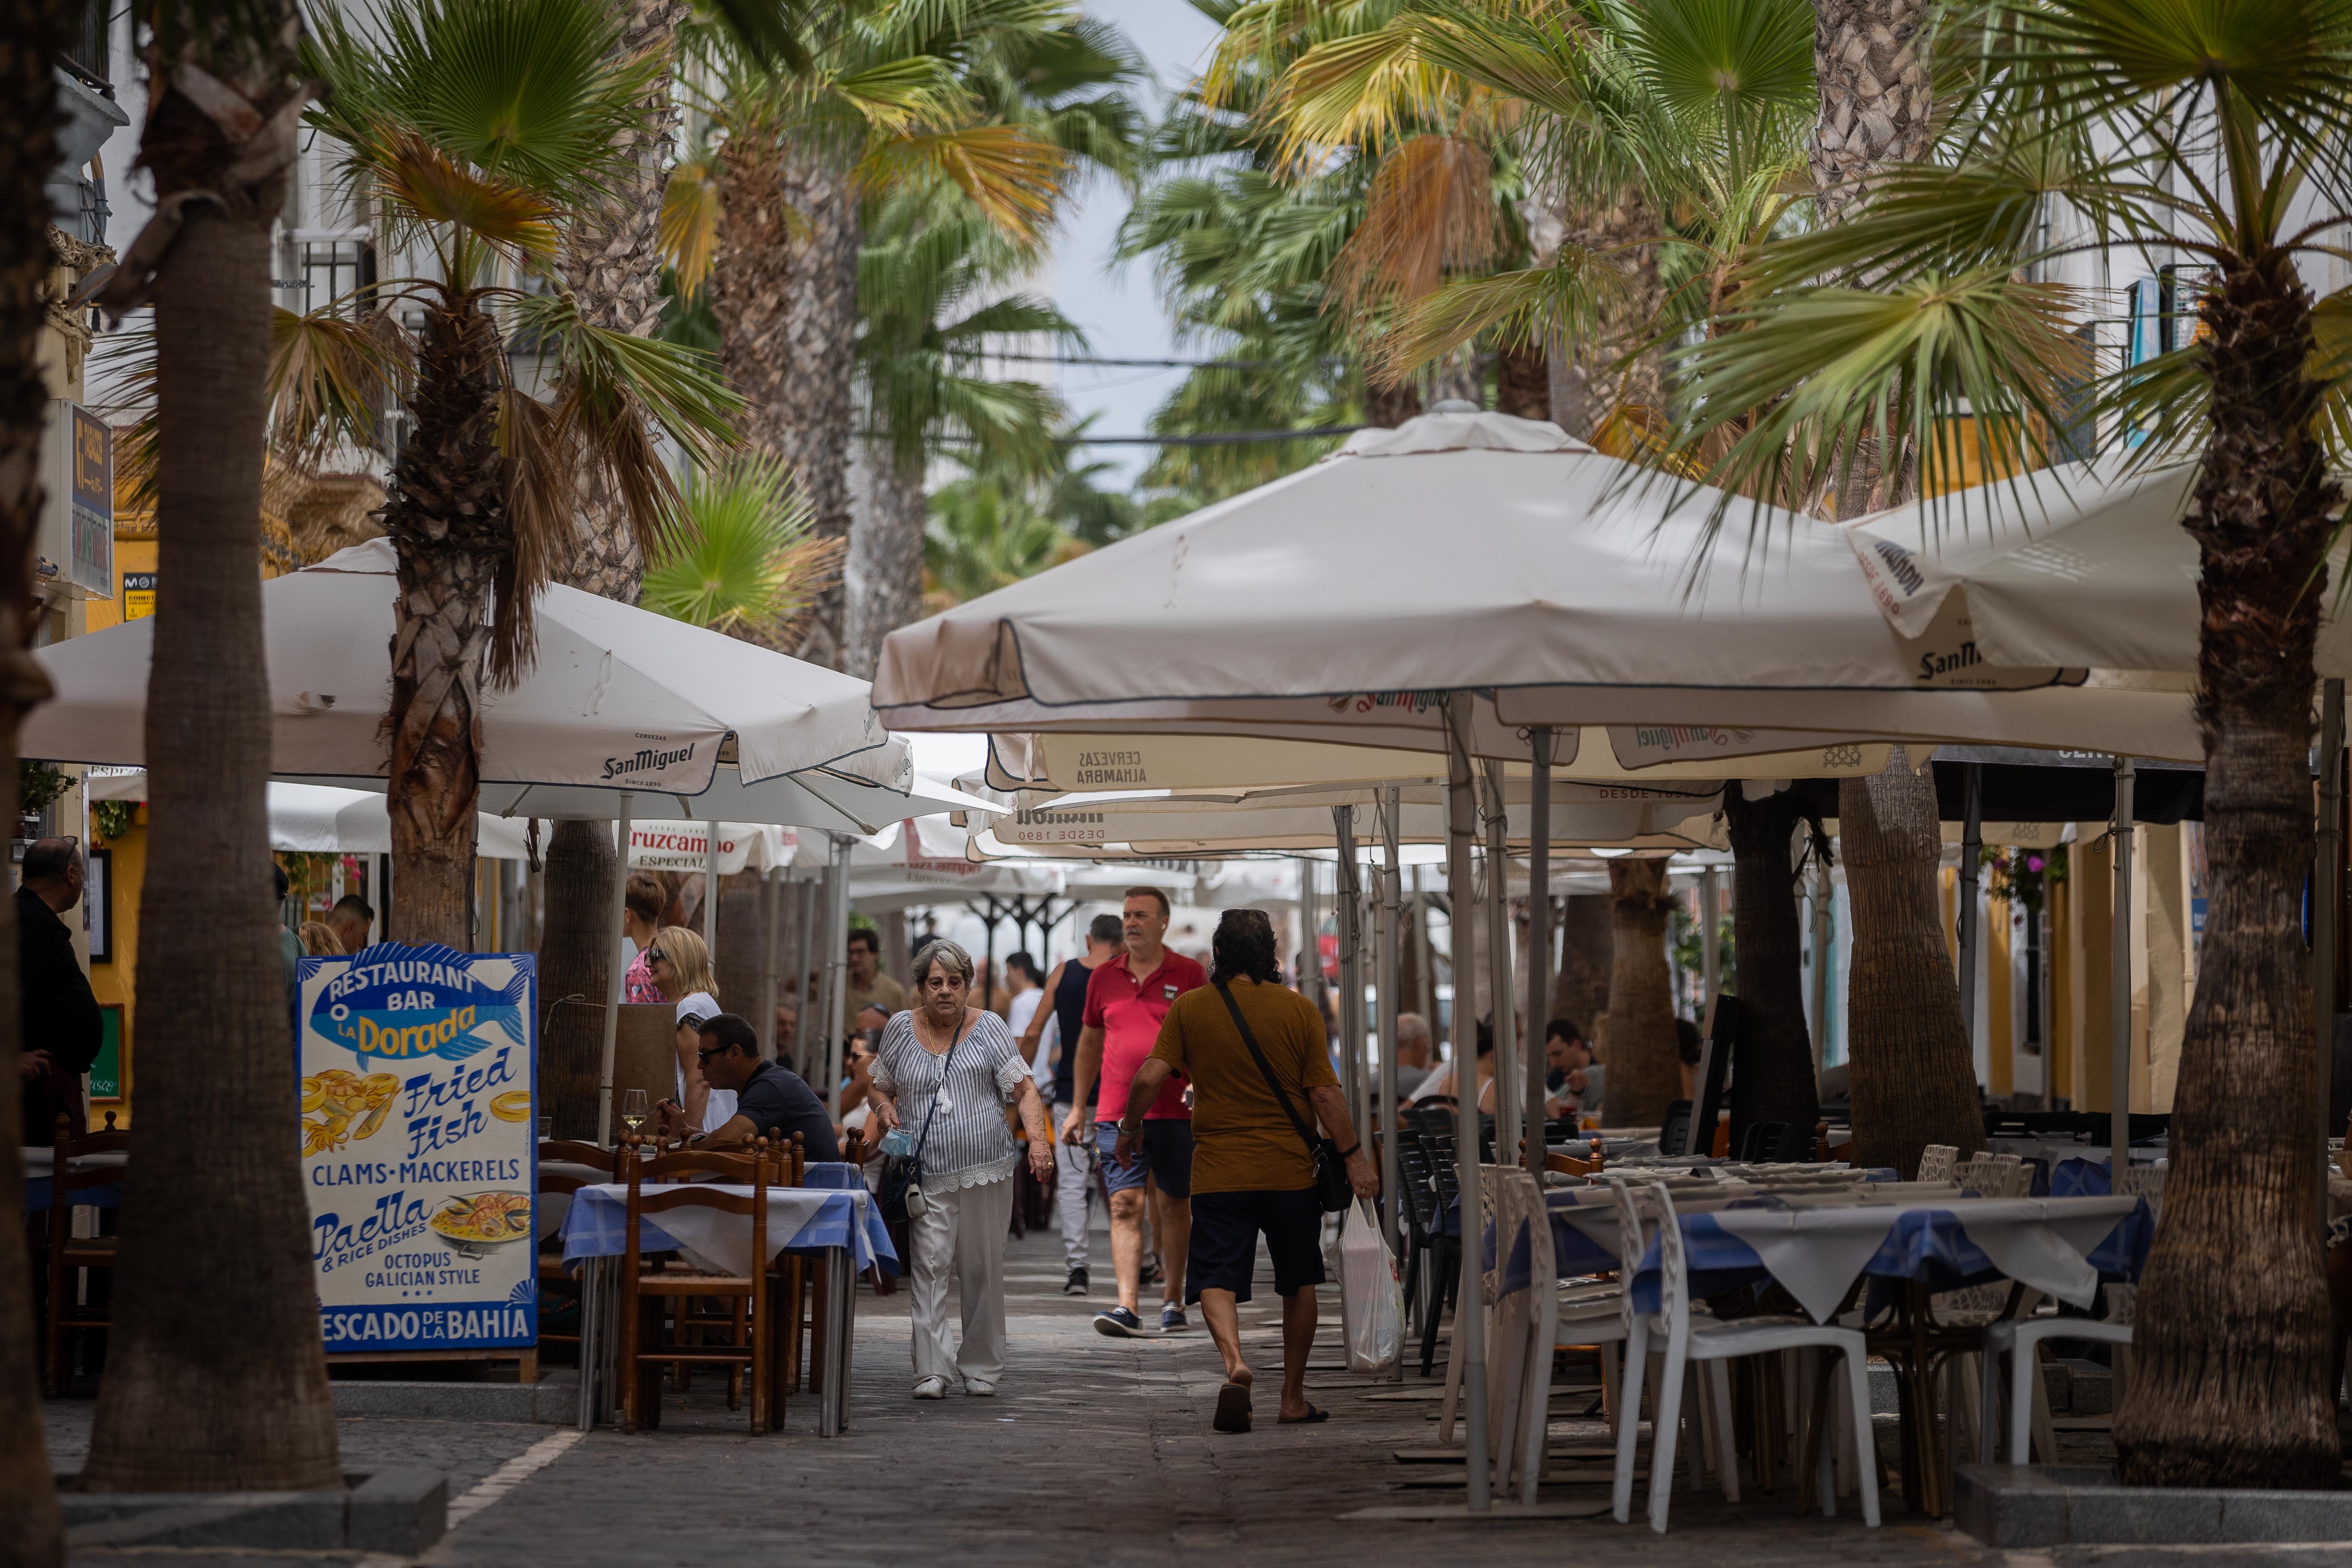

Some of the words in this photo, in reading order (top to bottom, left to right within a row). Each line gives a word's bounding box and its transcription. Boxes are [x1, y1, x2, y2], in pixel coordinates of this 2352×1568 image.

[84, 422, 103, 466] TABACOS
[1874, 581, 1900, 615] 1890
[635, 733, 667, 741] CERVEZAS
[1600, 790, 1649, 798] DESDE
[640, 855, 706, 869] ESPECIAL
[329, 961, 478, 1003] RESTAURANT
[387, 990, 435, 1011] BAR
[338, 1023, 356, 1040] LA
[359, 1004, 475, 1056] Dorada
[403, 1046, 517, 1118] Fried
[407, 1099, 488, 1160] Fish
[313, 1163, 388, 1186] CLAMS
[400, 1159, 520, 1184] MACKERELS
[312, 1190, 434, 1260] Paella
[321, 1256, 335, 1273] &
[337, 1246, 373, 1268] RICE
[378, 1222, 427, 1250] DISHES
[385, 1252, 451, 1270] OCTOPUS
[365, 1271, 435, 1288] GALICIAN
[439, 1268, 480, 1285] STYLE
[422, 1310, 445, 1325] DE
[422, 1325, 446, 1339] LA
